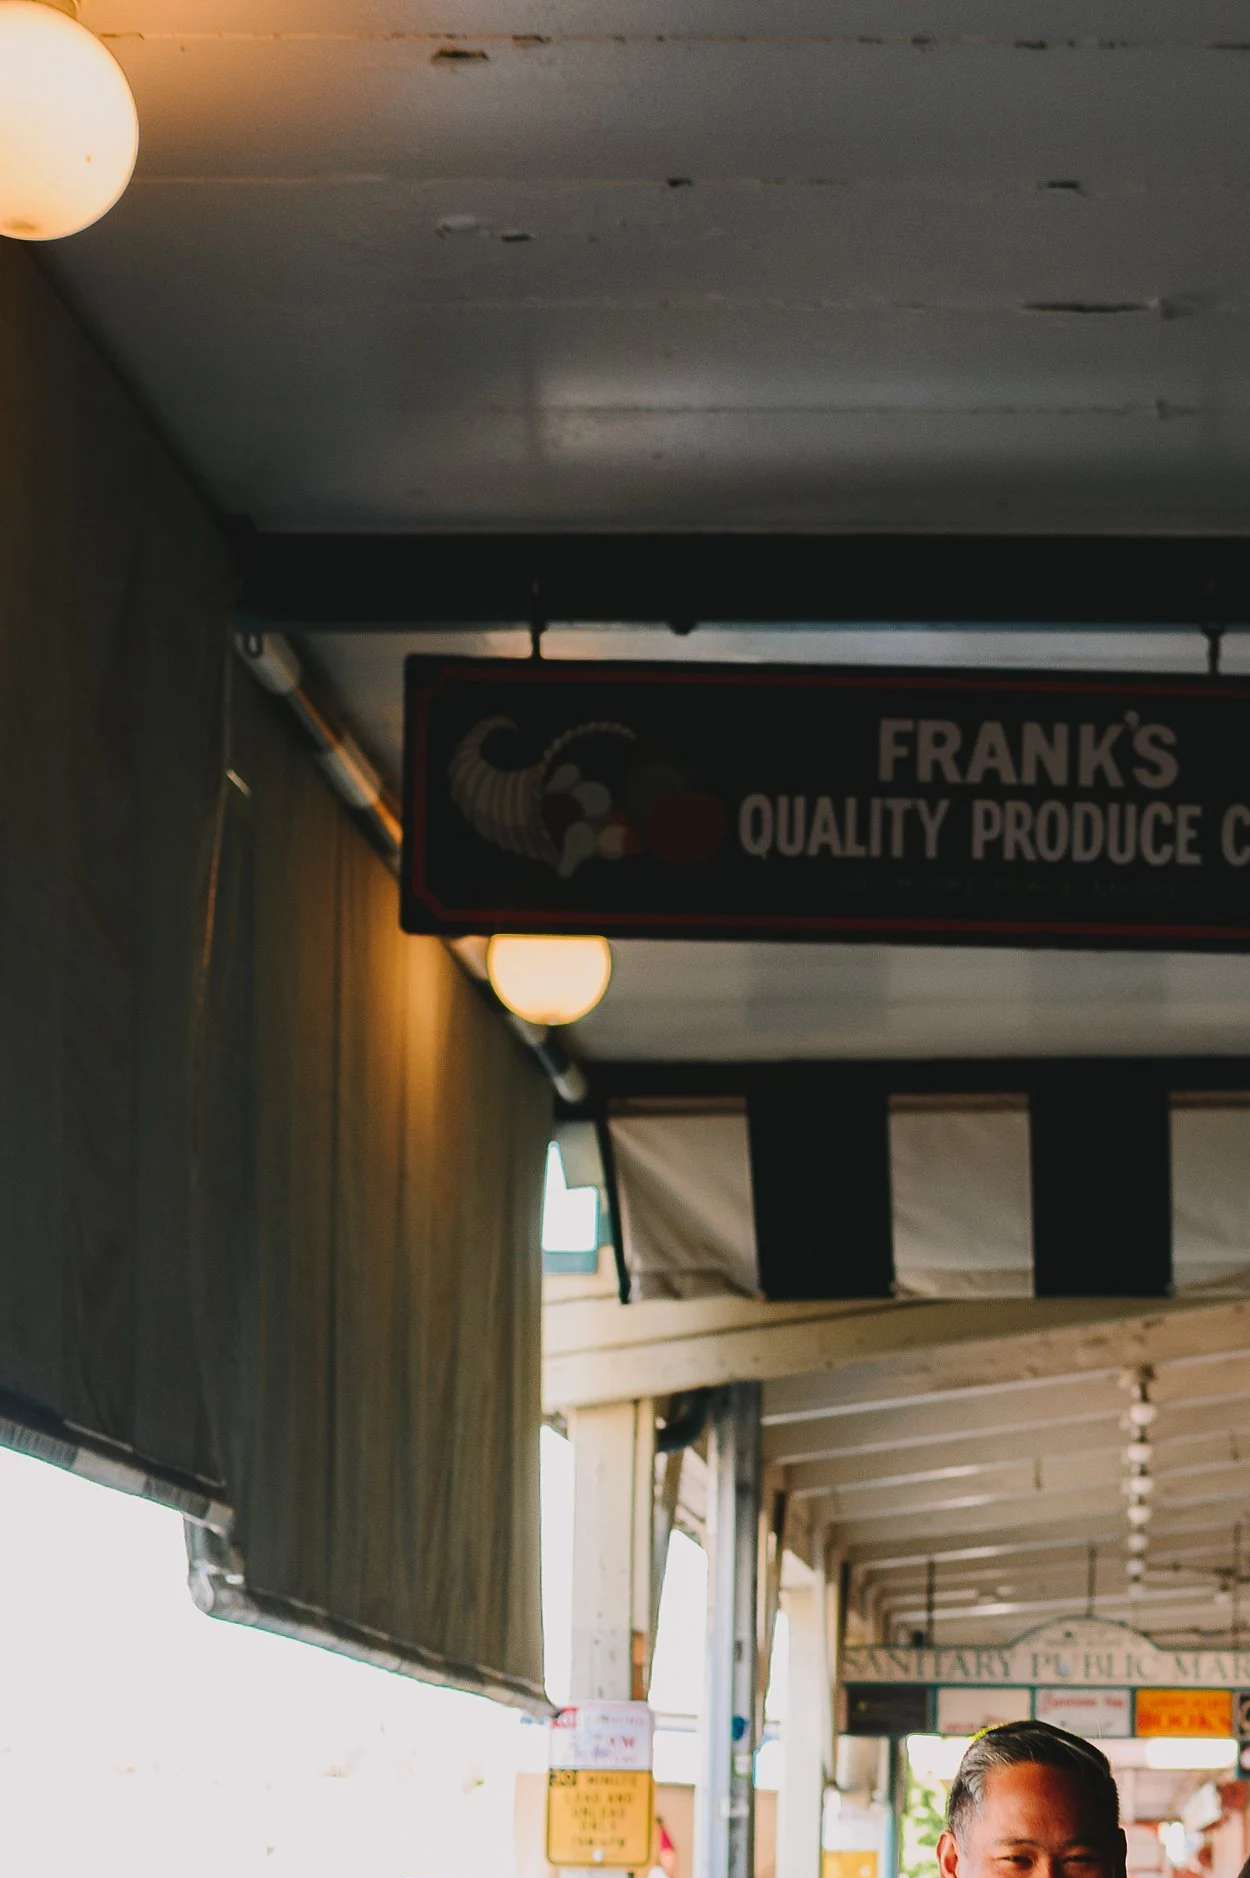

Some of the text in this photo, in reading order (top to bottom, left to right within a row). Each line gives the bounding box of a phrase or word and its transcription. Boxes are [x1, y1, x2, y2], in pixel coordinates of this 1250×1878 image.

[877, 710, 1180, 790] FRANK'S
[739, 794, 949, 860] QUALITY
[972, 801, 1203, 866] PRODUCE
[841, 1650, 1011, 1680] SANITARY
[1031, 1651, 1159, 1681] PUBLIC
